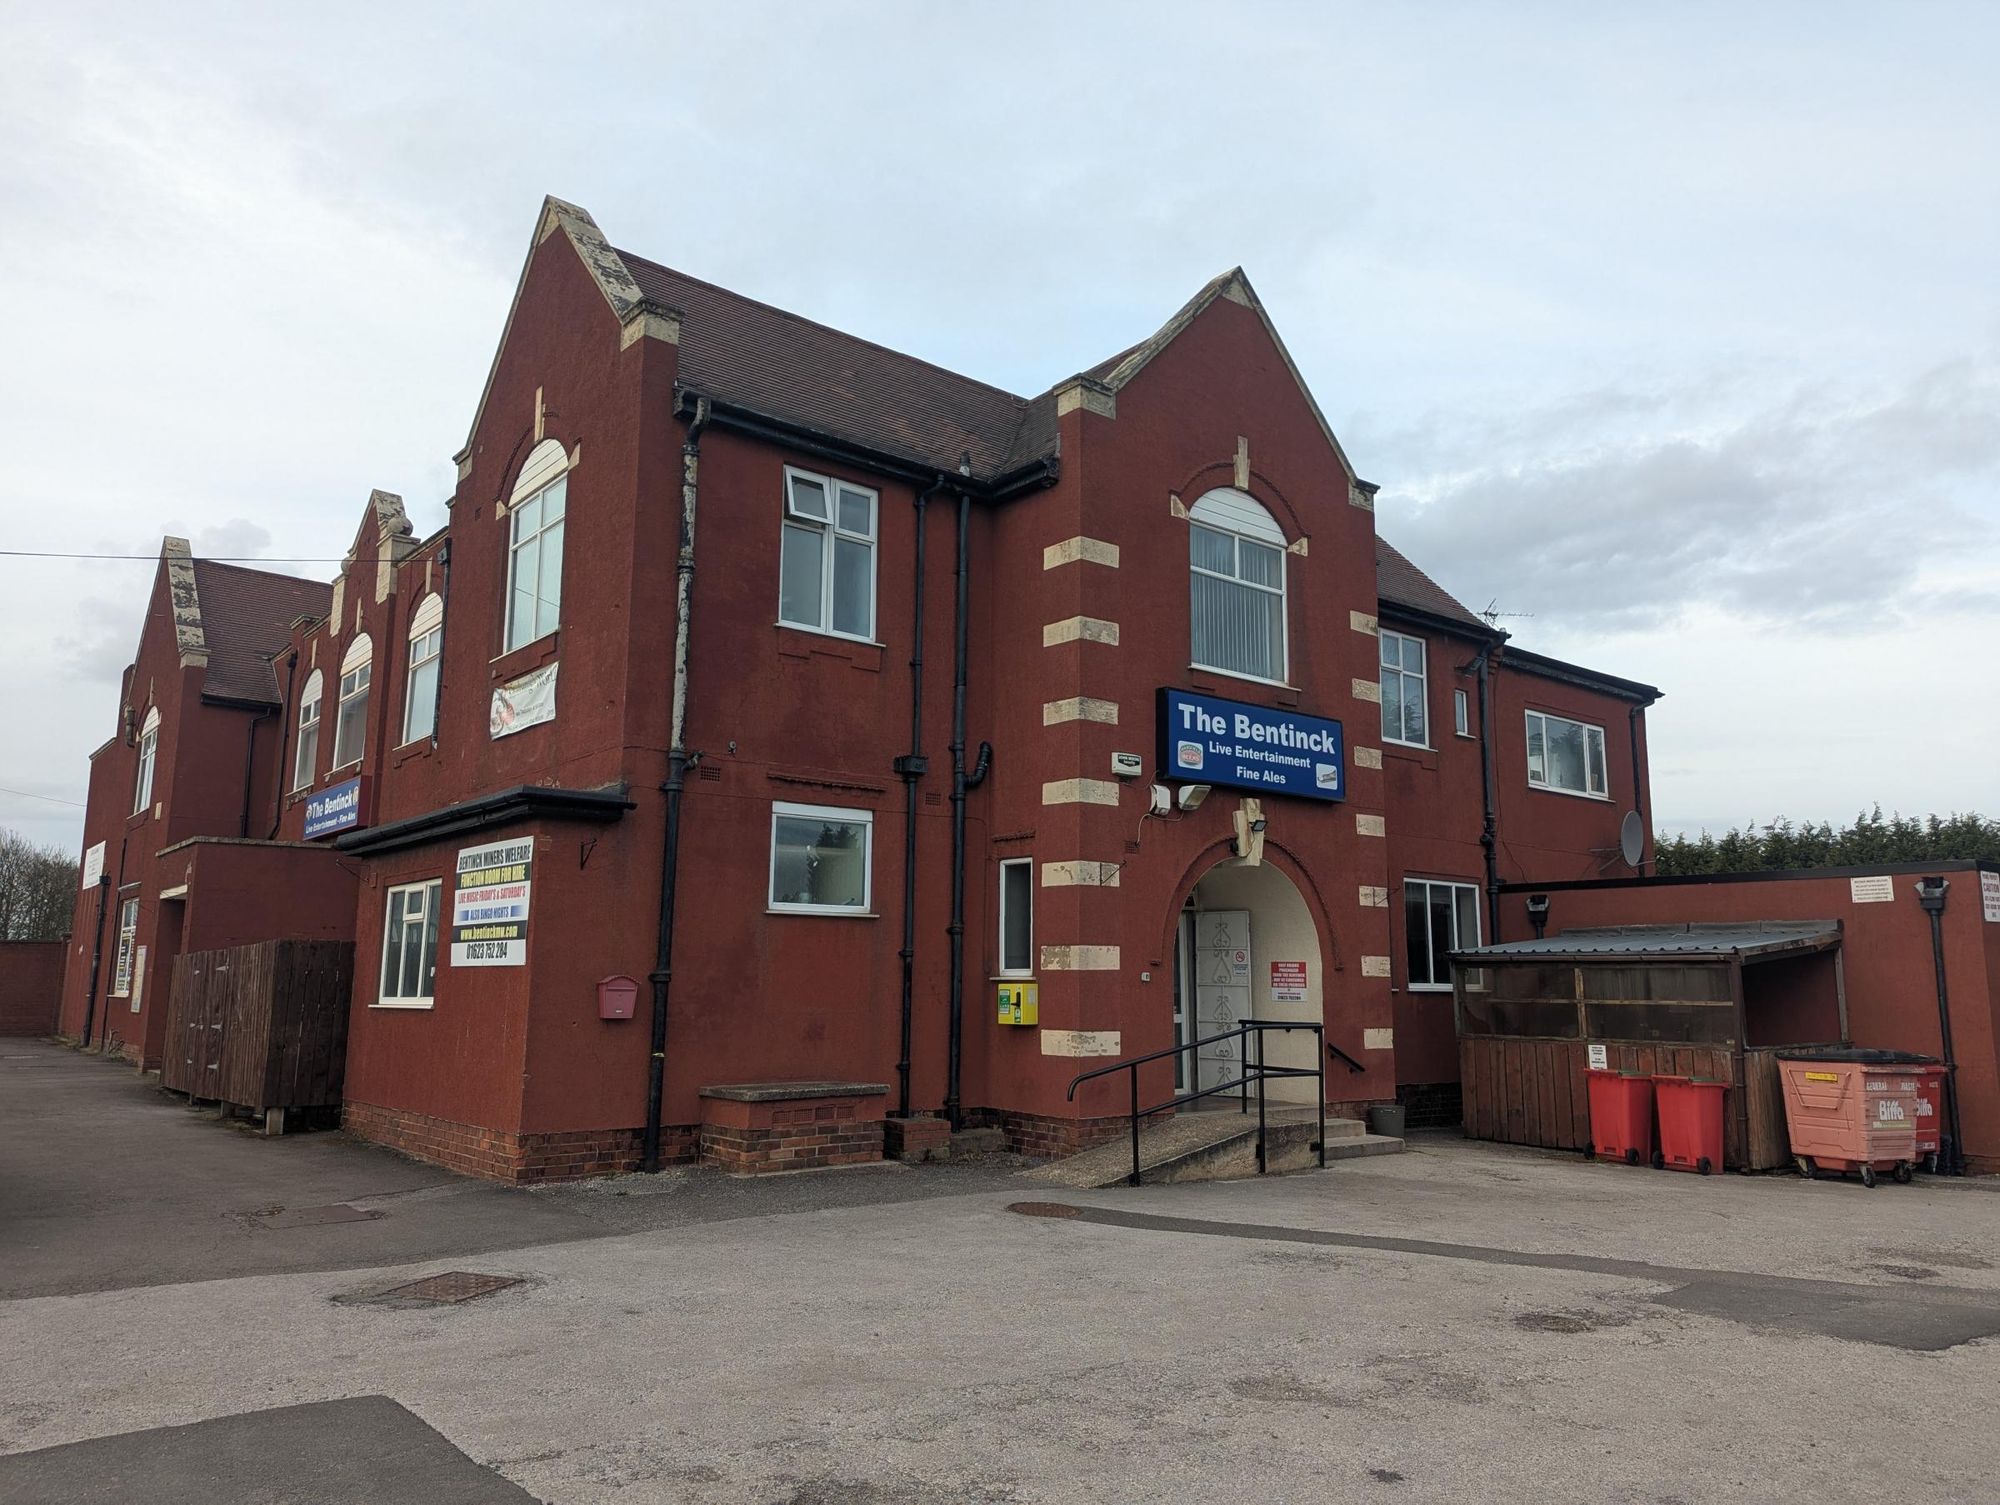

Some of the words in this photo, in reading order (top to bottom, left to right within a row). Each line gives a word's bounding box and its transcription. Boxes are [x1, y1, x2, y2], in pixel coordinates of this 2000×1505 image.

[1178, 703, 1227, 735] The
[1235, 713, 1335, 754] Bentinck
[1209, 741, 1232, 756] Live
[1235, 746, 1311, 768] Entertainment
[1237, 766, 1260, 780] Fine
[1263, 770, 1286, 784] Ales
[313, 802, 323, 818] The
[325, 790, 352, 815] Bentinck
[458, 853, 483, 871] BENTINCK
[483, 848, 504, 867] MINERS
[504, 844, 531, 863] WELFARE
[461, 870, 485, 888] FUNCTION
[485, 867, 501, 885] ROOM
[501, 866, 512, 883] FOR
[512, 864, 526, 881] HIRE
[470, 909, 480, 921] ALSO
[480, 907, 493, 920] BINGO
[493, 906, 509, 919] NIGHTS
[466, 943, 485, 960] 01623
[485, 942, 495, 959] 752
[495, 942, 508, 959] 284
[1879, 1100, 1904, 1121] Biffa
